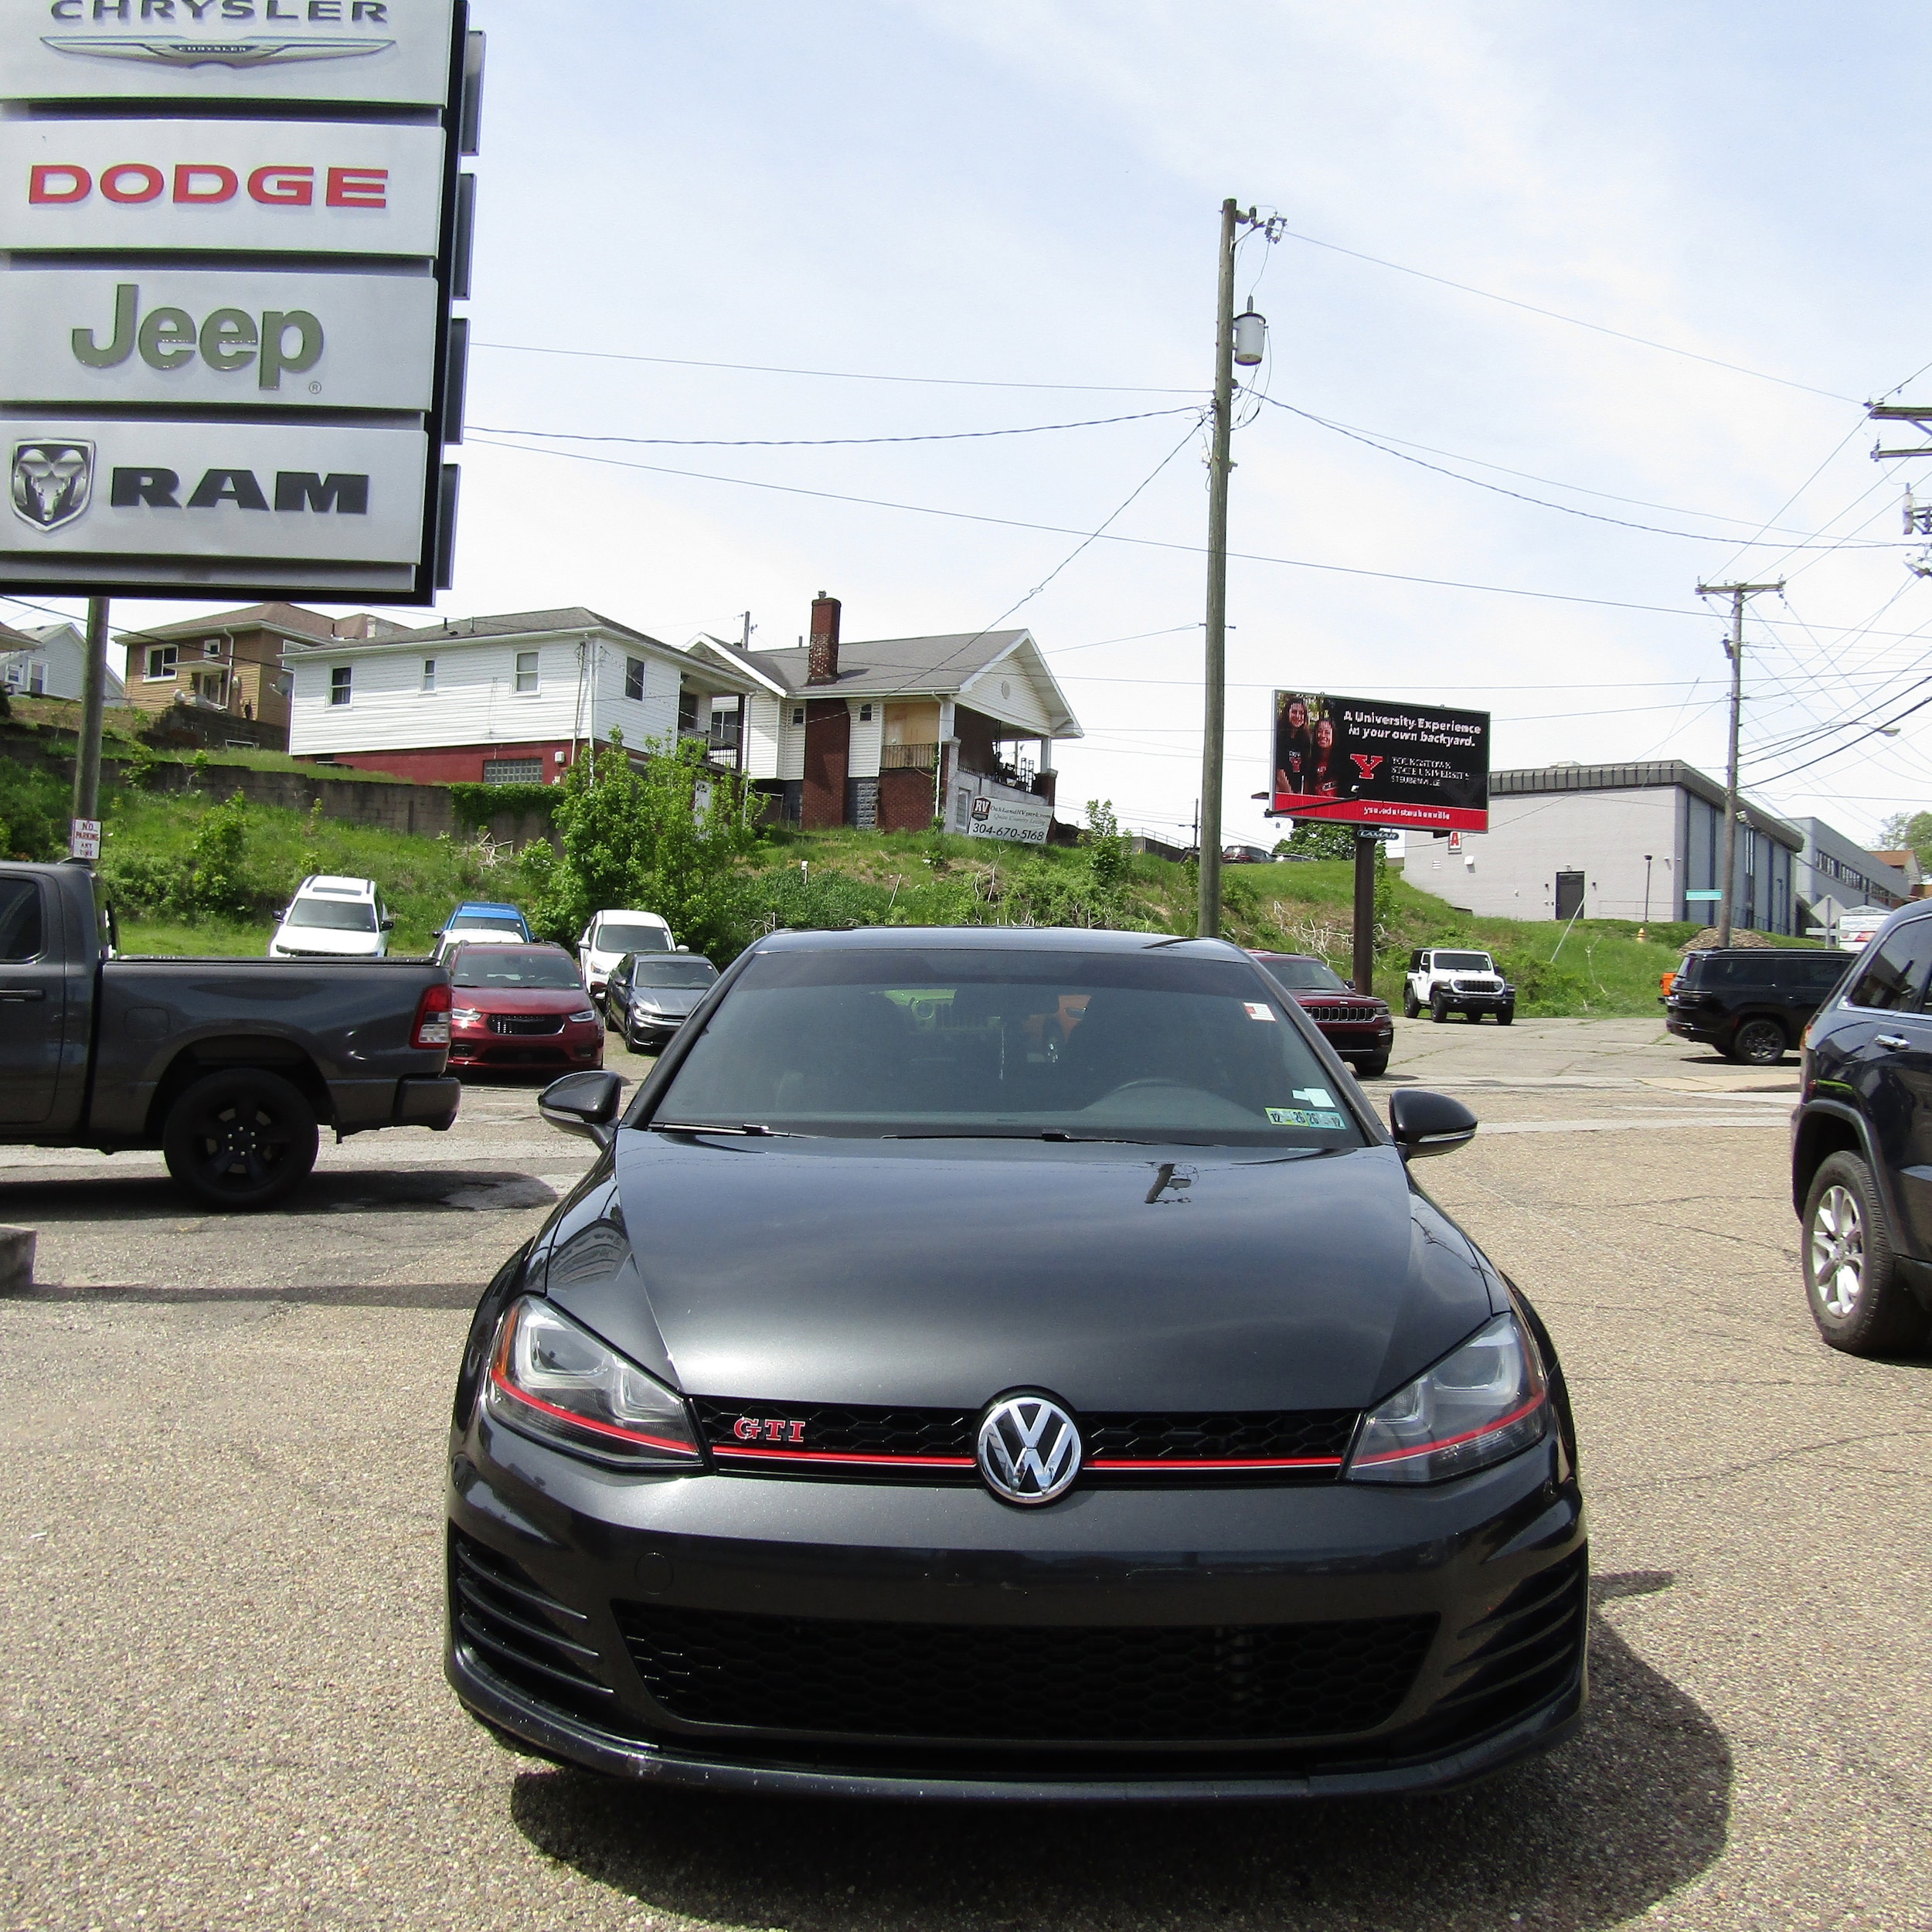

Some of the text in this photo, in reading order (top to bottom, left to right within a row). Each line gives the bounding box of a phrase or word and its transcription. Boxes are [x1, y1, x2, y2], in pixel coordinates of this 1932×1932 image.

[51, 0, 388, 22] CHRYSLER
[29, 164, 388, 208] DODGE
[72, 284, 324, 390] Jeep
[111, 467, 369, 515] RAM
[1343, 710, 1481, 734] A University Experience
[1349, 723, 1475, 747] in your own backyard.
[975, 800, 989, 812] RV
[76, 832, 99, 841] PARKING
[82, 822, 94, 831] NO
[973, 823, 1044, 841] 304-670-5168
[1360, 830, 1396, 840] LAMAR
[1451, 832, 1459, 846] A
[1294, 1111, 1306, 1124] 26
[734, 1417, 805, 1443] GTI
